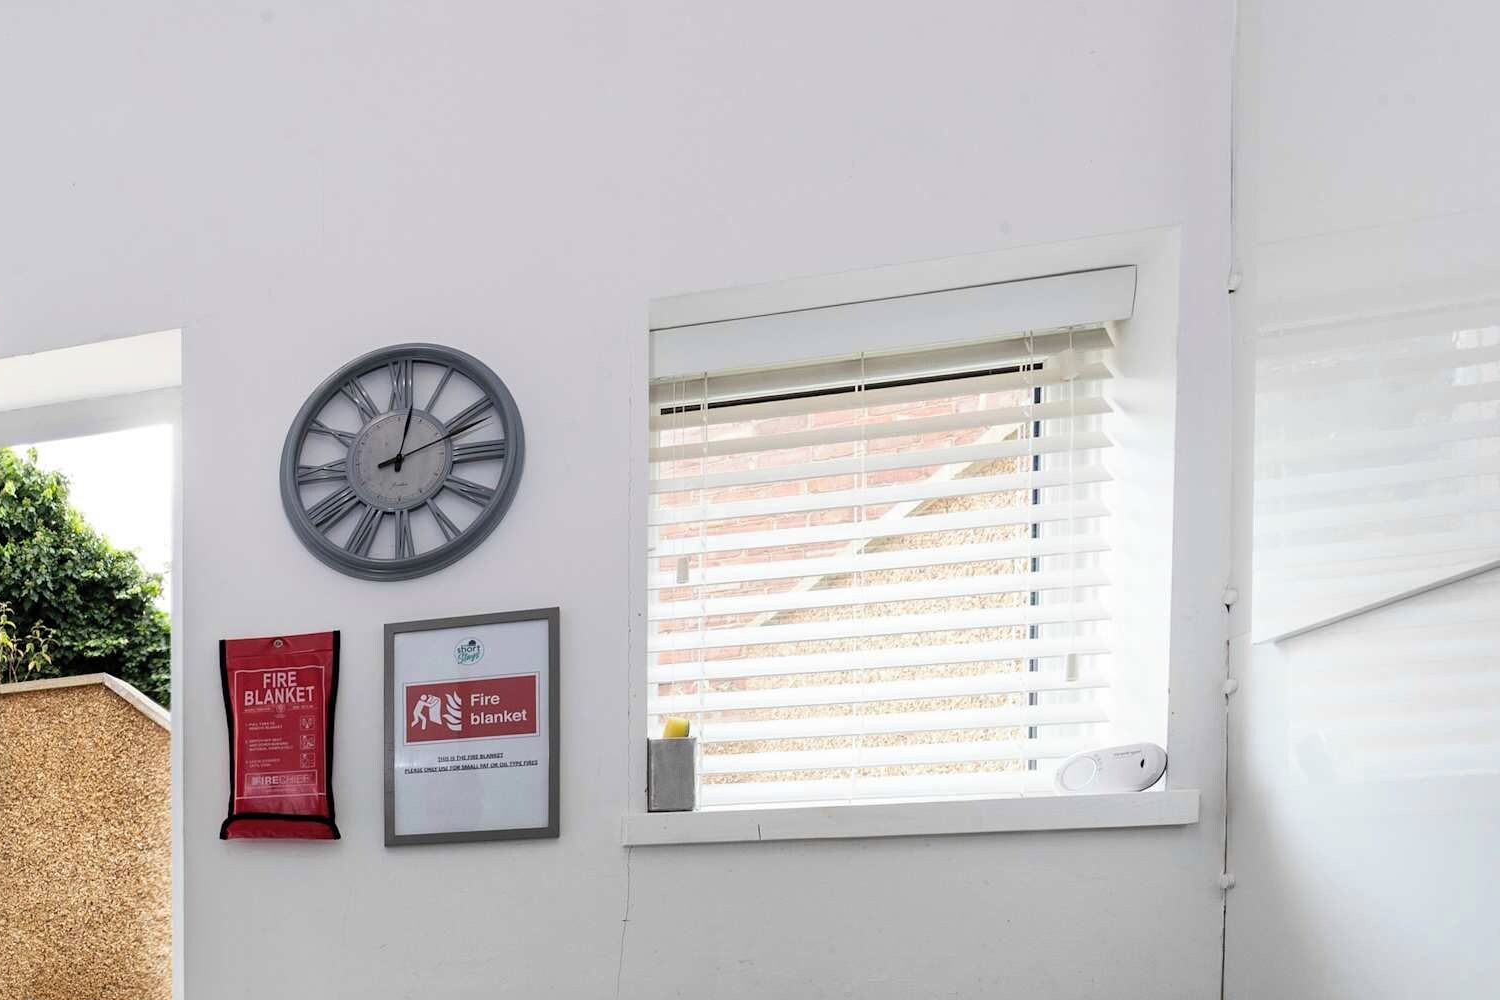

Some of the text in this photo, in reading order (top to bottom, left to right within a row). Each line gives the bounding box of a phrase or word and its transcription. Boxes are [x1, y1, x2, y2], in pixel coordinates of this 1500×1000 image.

[263, 671, 297, 688] FIRE
[244, 686, 315, 706] BLANKET
[471, 692, 500, 706] Fire
[471, 709, 527, 725] blanket
[480, 752, 504, 760] BLANKET
